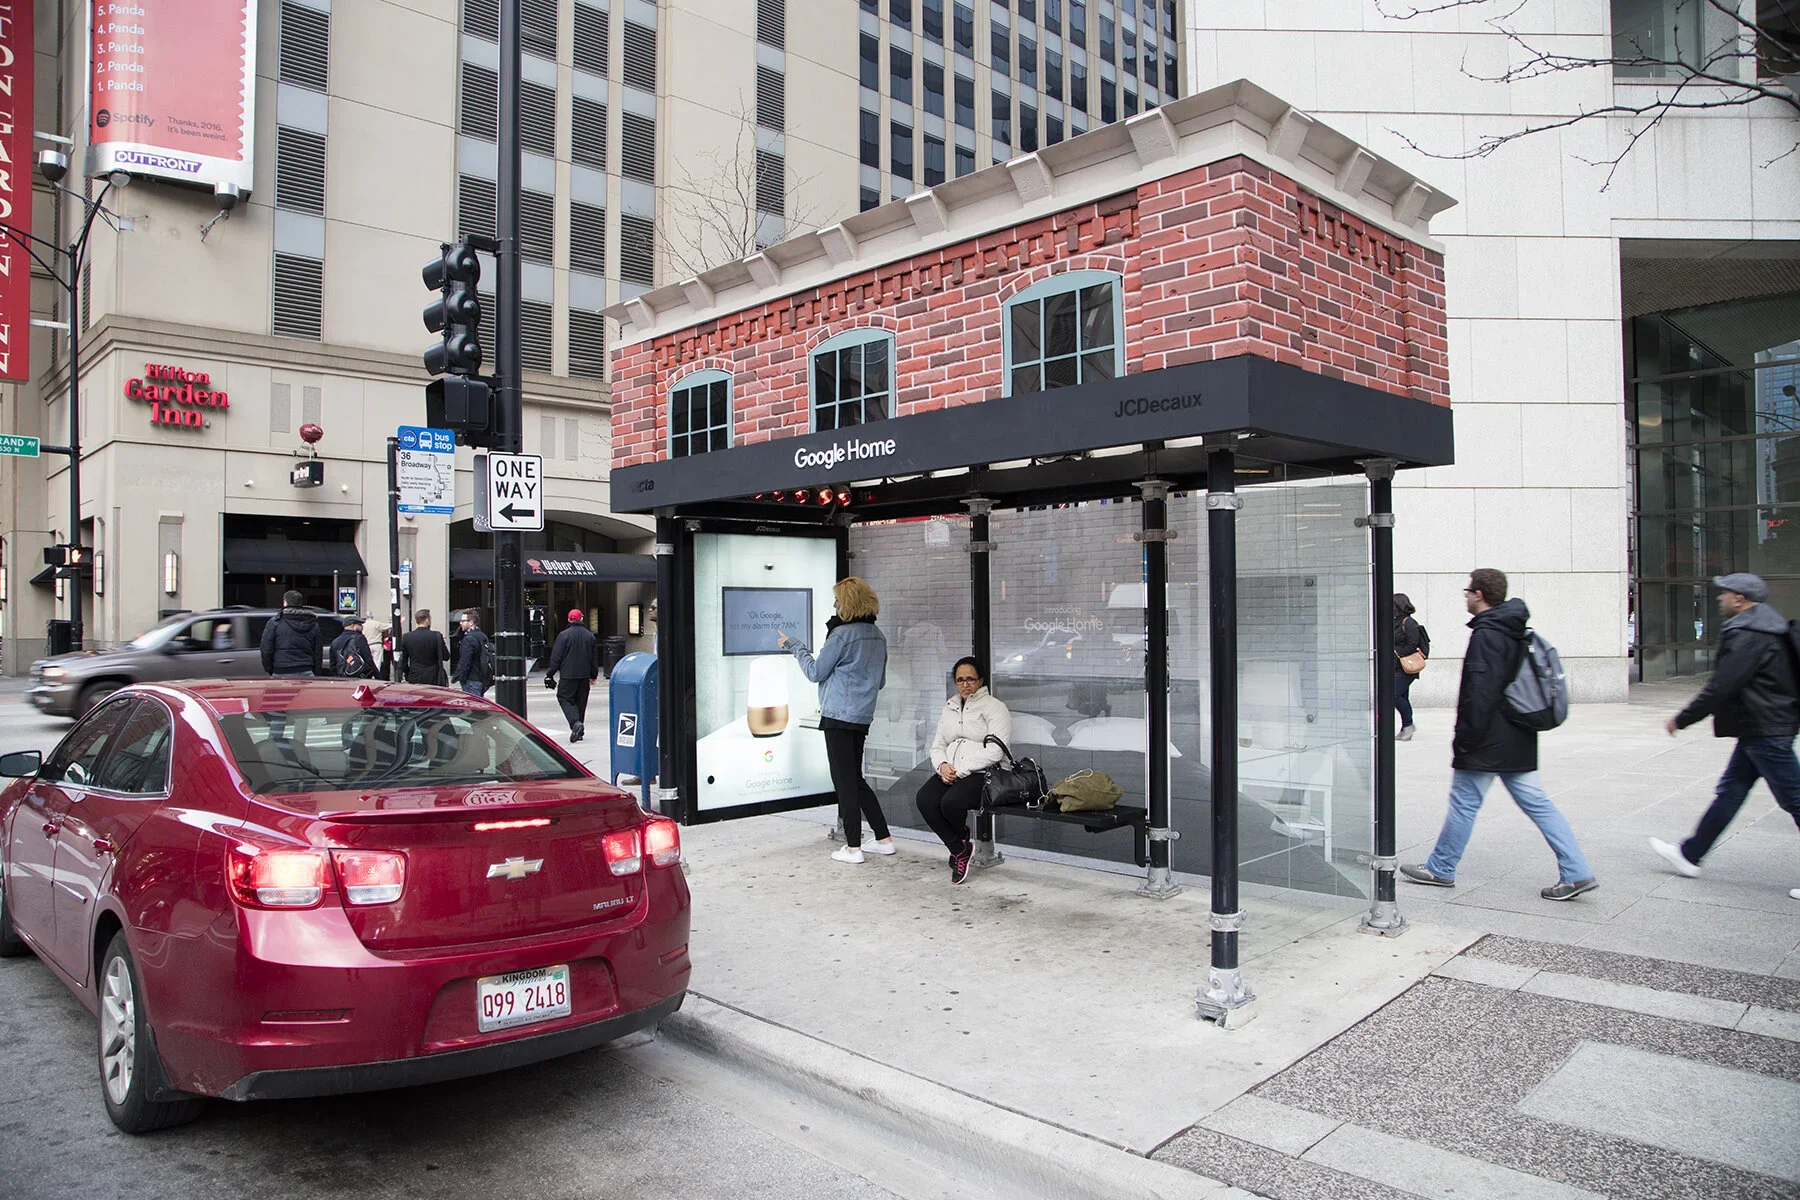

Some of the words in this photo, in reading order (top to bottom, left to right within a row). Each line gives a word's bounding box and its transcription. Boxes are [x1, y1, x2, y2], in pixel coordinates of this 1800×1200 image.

[97, 5, 106, 16] 5.
[108, 3, 145, 16] Panda
[97, 24, 106, 34] 4.
[108, 22, 145, 35] Panda
[97, 43, 106, 54] 3.
[108, 41, 144, 54] Panda
[97, 62, 105, 73] 2.
[107, 60, 144, 72] Panda
[97, 81, 104, 91] 1.
[107, 79, 143, 91] Panda
[113, 112, 155, 127] Spotify
[167, 116, 199, 128] Thanks,
[201, 121, 223, 132] 2016.
[167, 125, 178, 134] It's
[180, 127, 201, 137] been
[202, 131, 228, 141] weird.
[116, 151, 199, 172] OUTFRONT
[145, 363, 210, 384] Hilton
[124, 377, 230, 407] Garden
[1114, 393, 1202, 418] JCDecaux
[151, 401, 204, 427] Inn
[434, 432, 449, 442] bus
[434, 441, 453, 451] stop
[400, 451, 411, 460] 36
[794, 443, 845, 470] Google
[847, 438, 896, 461] Home
[400, 461, 431, 470] Broadway
[496, 459, 535, 479] ONE
[495, 480, 537, 499] WAY
[541, 559, 572, 571] Weber
[572, 559, 595, 571] Grill
[1043, 606, 1082, 615] Introducing
[740, 623, 751, 631] my
[752, 622, 770, 630] alarm
[771, 621, 781, 630] for
[1024, 617, 1065, 634] Google
[1066, 617, 1103, 631] Home
[745, 778, 771, 789] Google
[772, 776, 793, 785] Home
[593, 897, 624, 911] MALIBU
[626, 895, 634, 904] LT
[502, 968, 547, 983] KINGDOM
[483, 990, 515, 1018] Q99
[524, 981, 565, 1012] 2418
